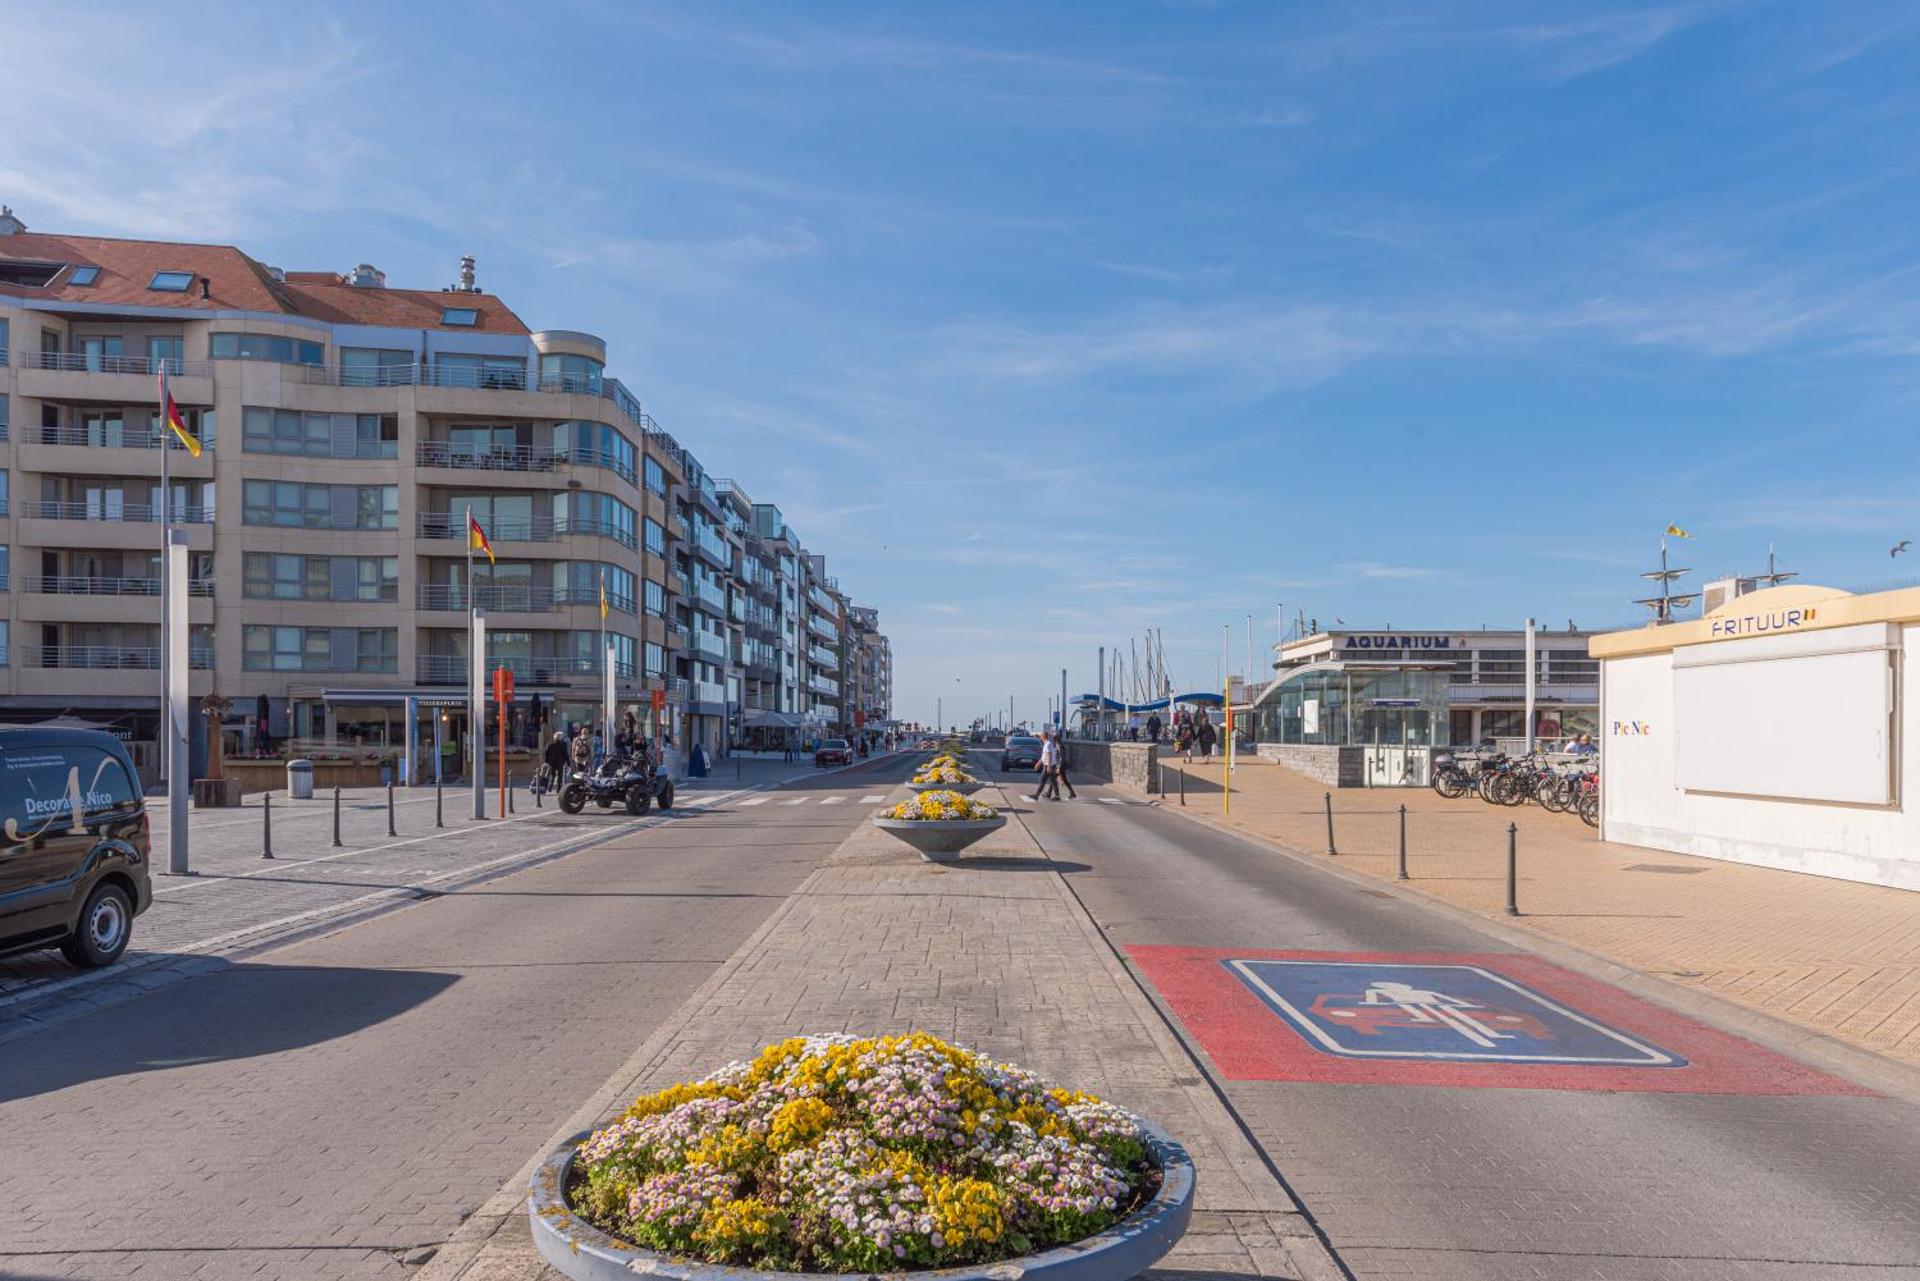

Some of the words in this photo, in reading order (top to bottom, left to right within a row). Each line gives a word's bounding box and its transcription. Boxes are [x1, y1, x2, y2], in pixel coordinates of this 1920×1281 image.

[1712, 610, 1800, 636] FRITUUR
[1346, 635, 1449, 648] AQUARIUM
[1614, 721, 1629, 736] Pic
[86, 791, 112, 806] Nico
